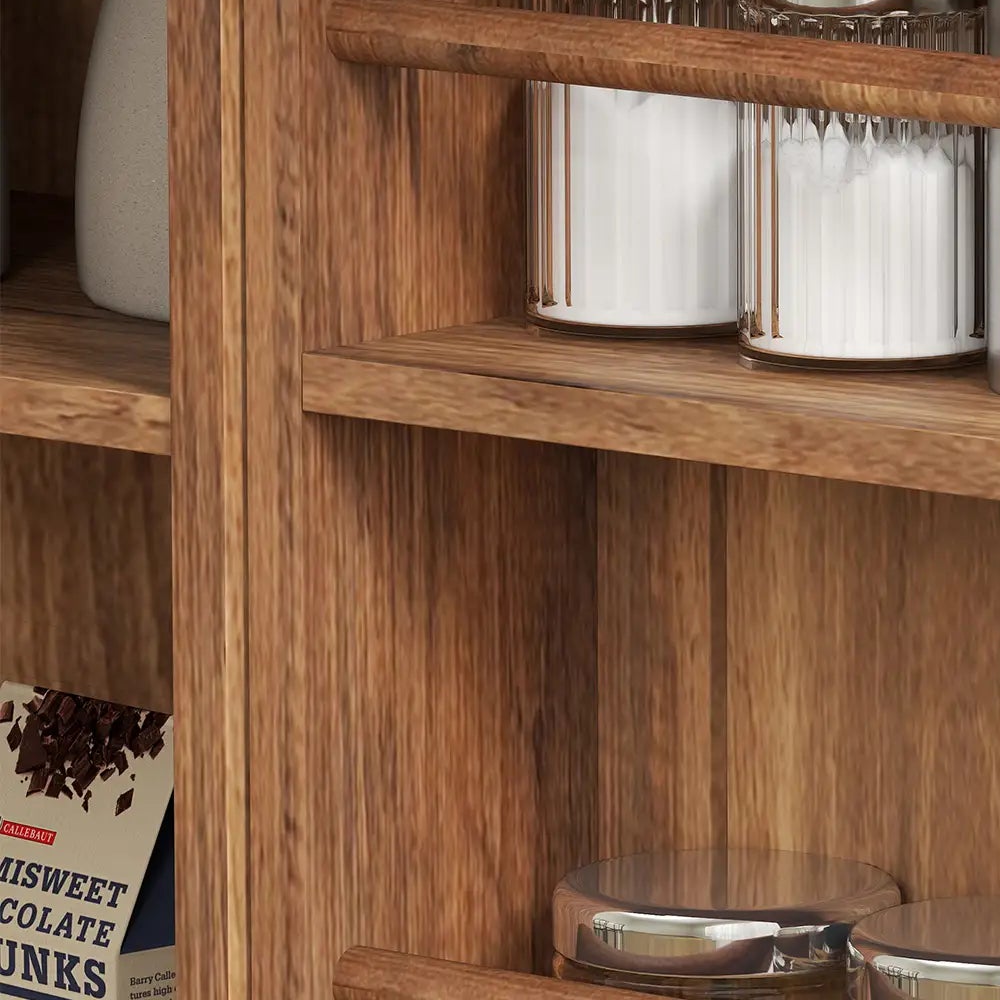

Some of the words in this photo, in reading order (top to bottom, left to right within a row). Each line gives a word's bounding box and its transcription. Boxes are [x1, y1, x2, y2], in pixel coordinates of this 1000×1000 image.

[3, 823, 53, 843] CALLEBAUT
[0, 898, 116, 948] COLATE
[130, 976, 153, 986] Barry
[130, 990, 151, 1000] tures
[153, 985, 172, 996] high
